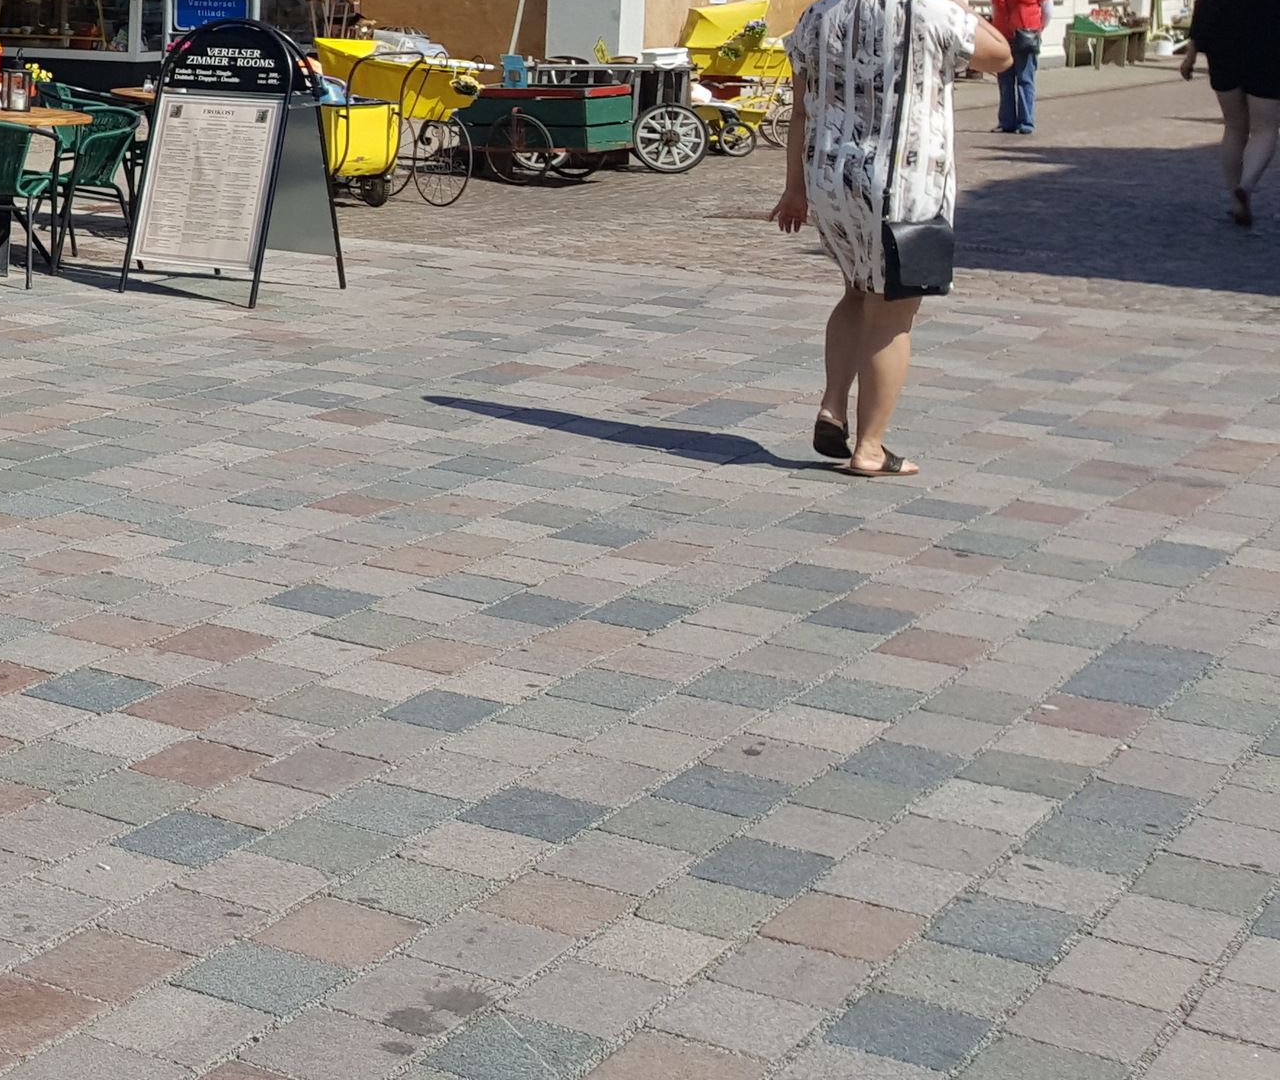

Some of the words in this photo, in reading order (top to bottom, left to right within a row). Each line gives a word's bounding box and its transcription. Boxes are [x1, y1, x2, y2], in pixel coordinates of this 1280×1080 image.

[207, 47, 261, 58] VÆRELSER
[186, 55, 229, 66] ZIMMER
[236, 58, 275, 68] ROOMS
